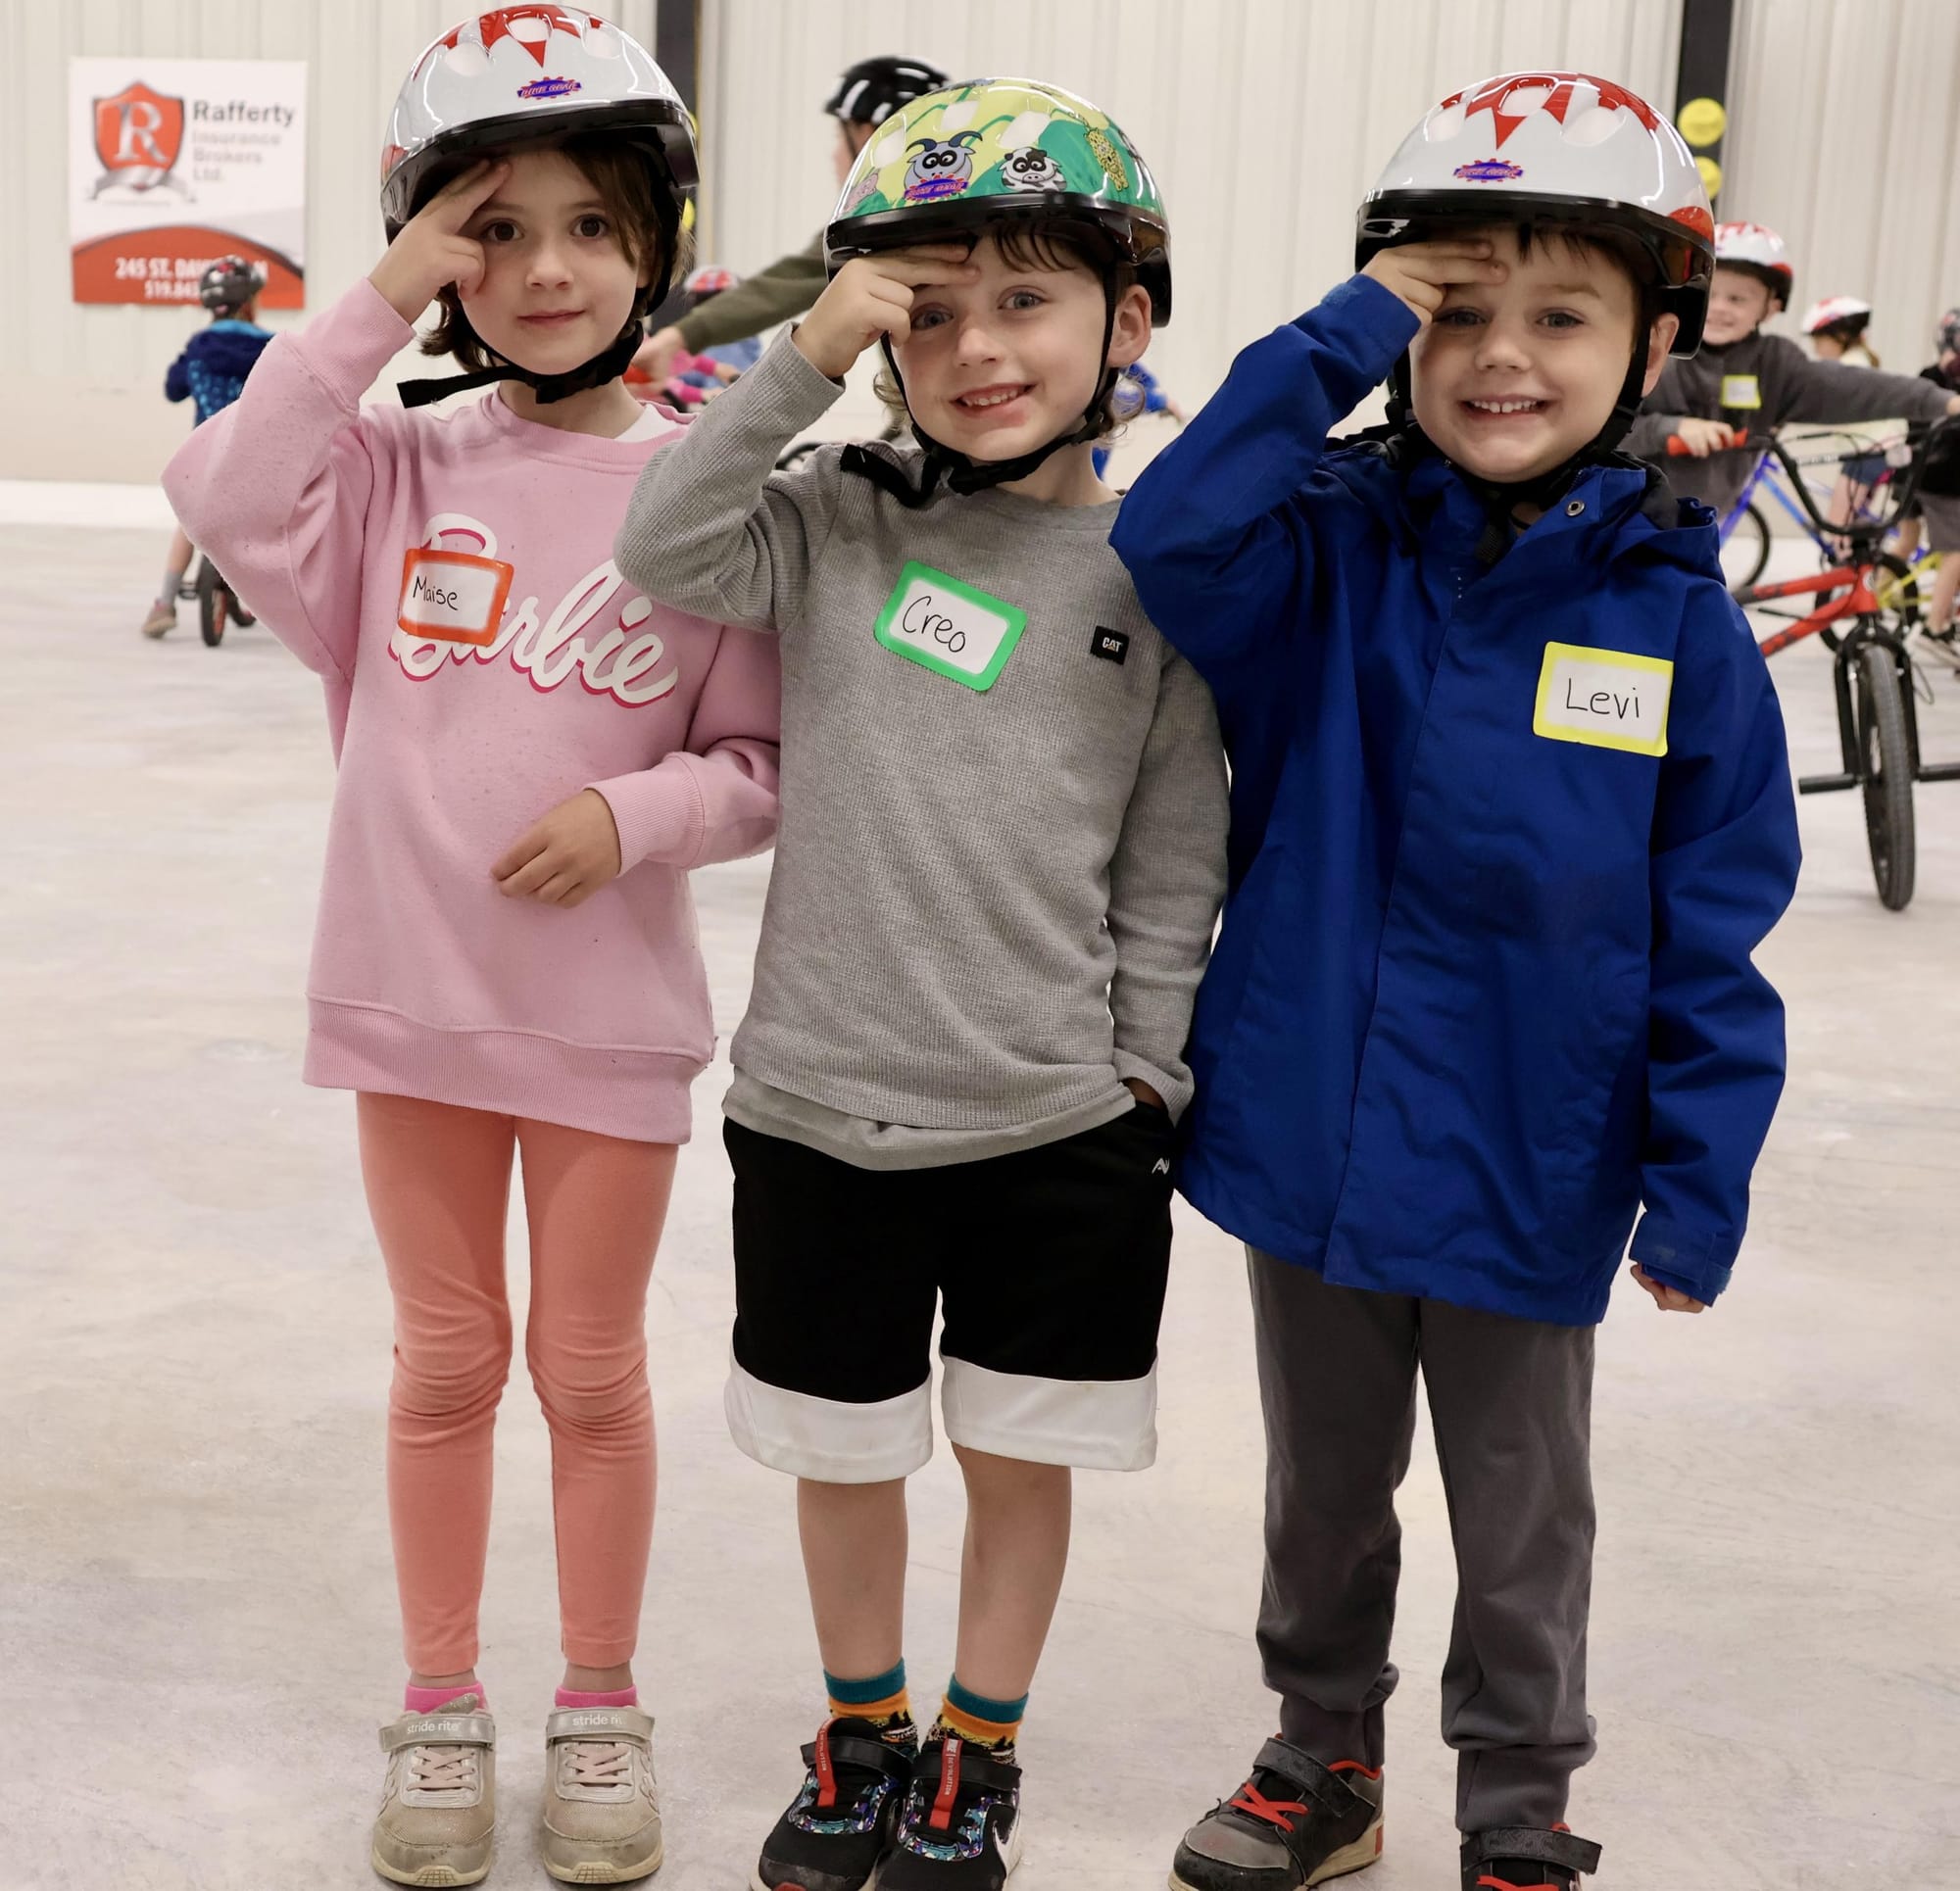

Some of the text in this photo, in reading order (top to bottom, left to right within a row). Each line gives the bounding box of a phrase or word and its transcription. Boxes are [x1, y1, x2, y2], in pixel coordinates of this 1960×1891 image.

[192, 100, 295, 127] Rafferty
[192, 148, 263, 163] Brokers
[115, 257, 147, 280] 245
[413, 576, 459, 610] Maise
[903, 596, 966, 653] Creo
[1102, 637, 1123, 653] CAT
[1566, 678, 1640, 719] Levi
[407, 1721, 435, 1734] stride
[572, 1714, 609, 1725] stride
